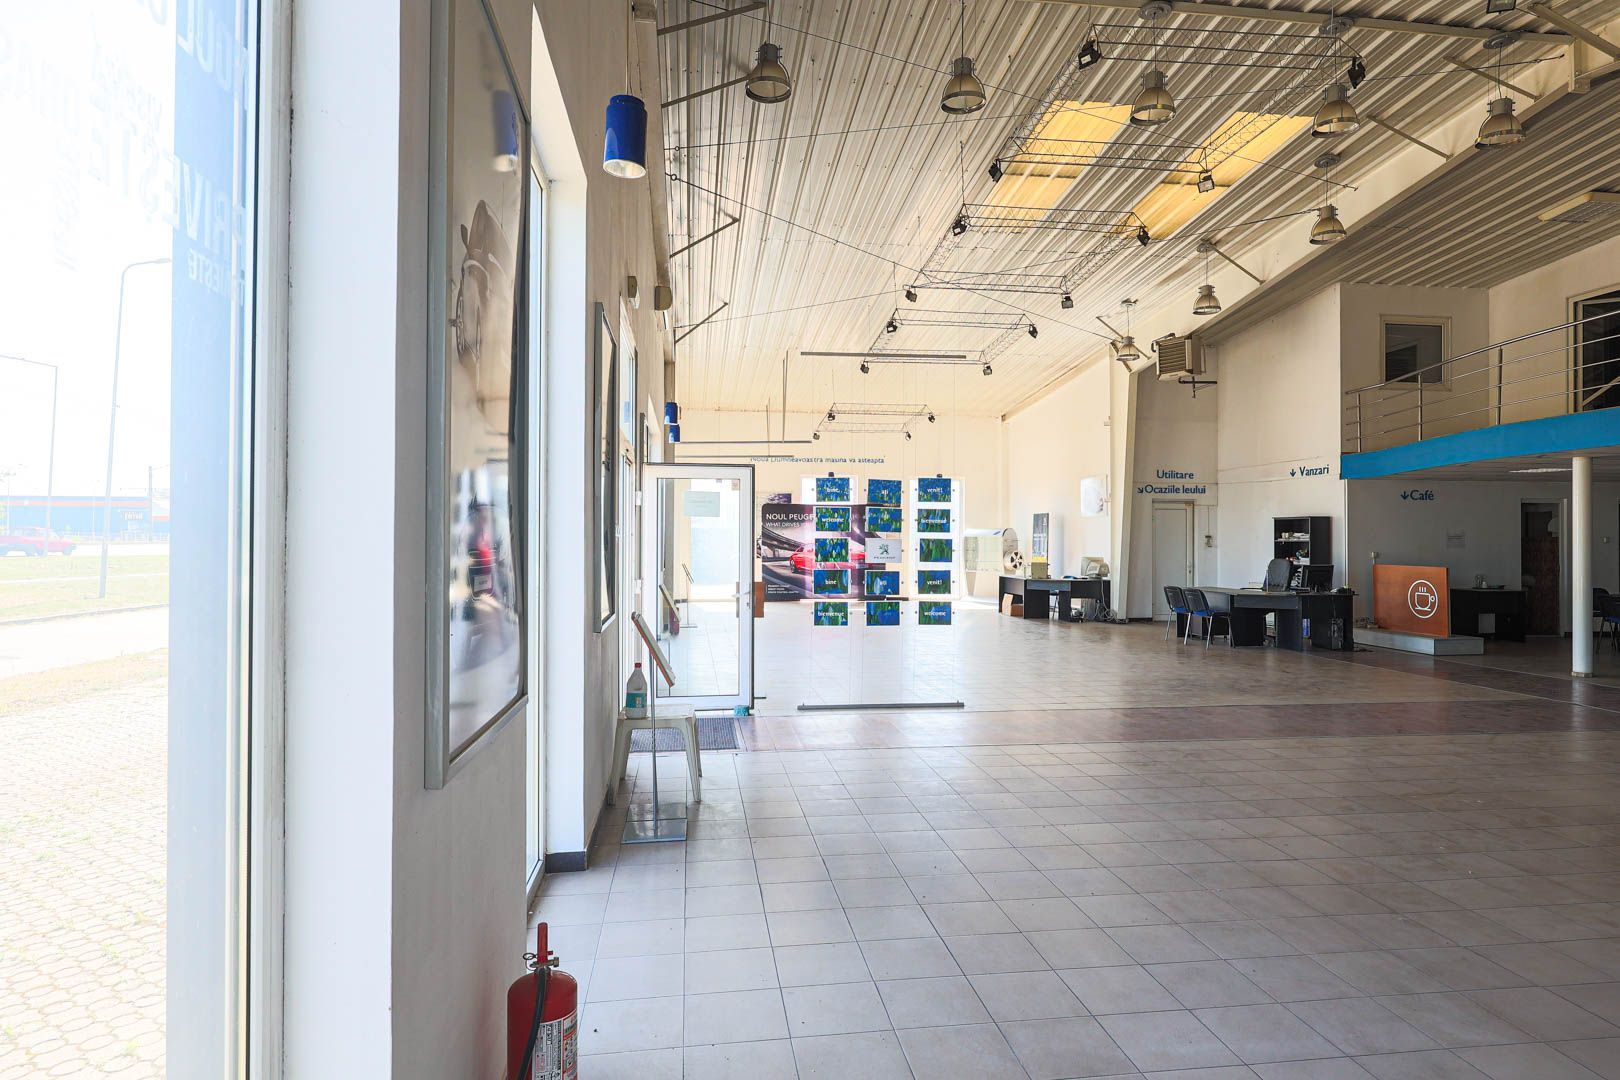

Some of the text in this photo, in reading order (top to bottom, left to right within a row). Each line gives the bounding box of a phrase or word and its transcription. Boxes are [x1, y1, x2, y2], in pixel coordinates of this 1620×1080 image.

[1156, 469, 1194, 480] Utilitare
[1299, 465, 1330, 477] Vanzari
[1145, 484, 1180, 494] Ocaziile
[1410, 489, 1434, 501] Café
[789, 513, 815, 521] PEUGE
